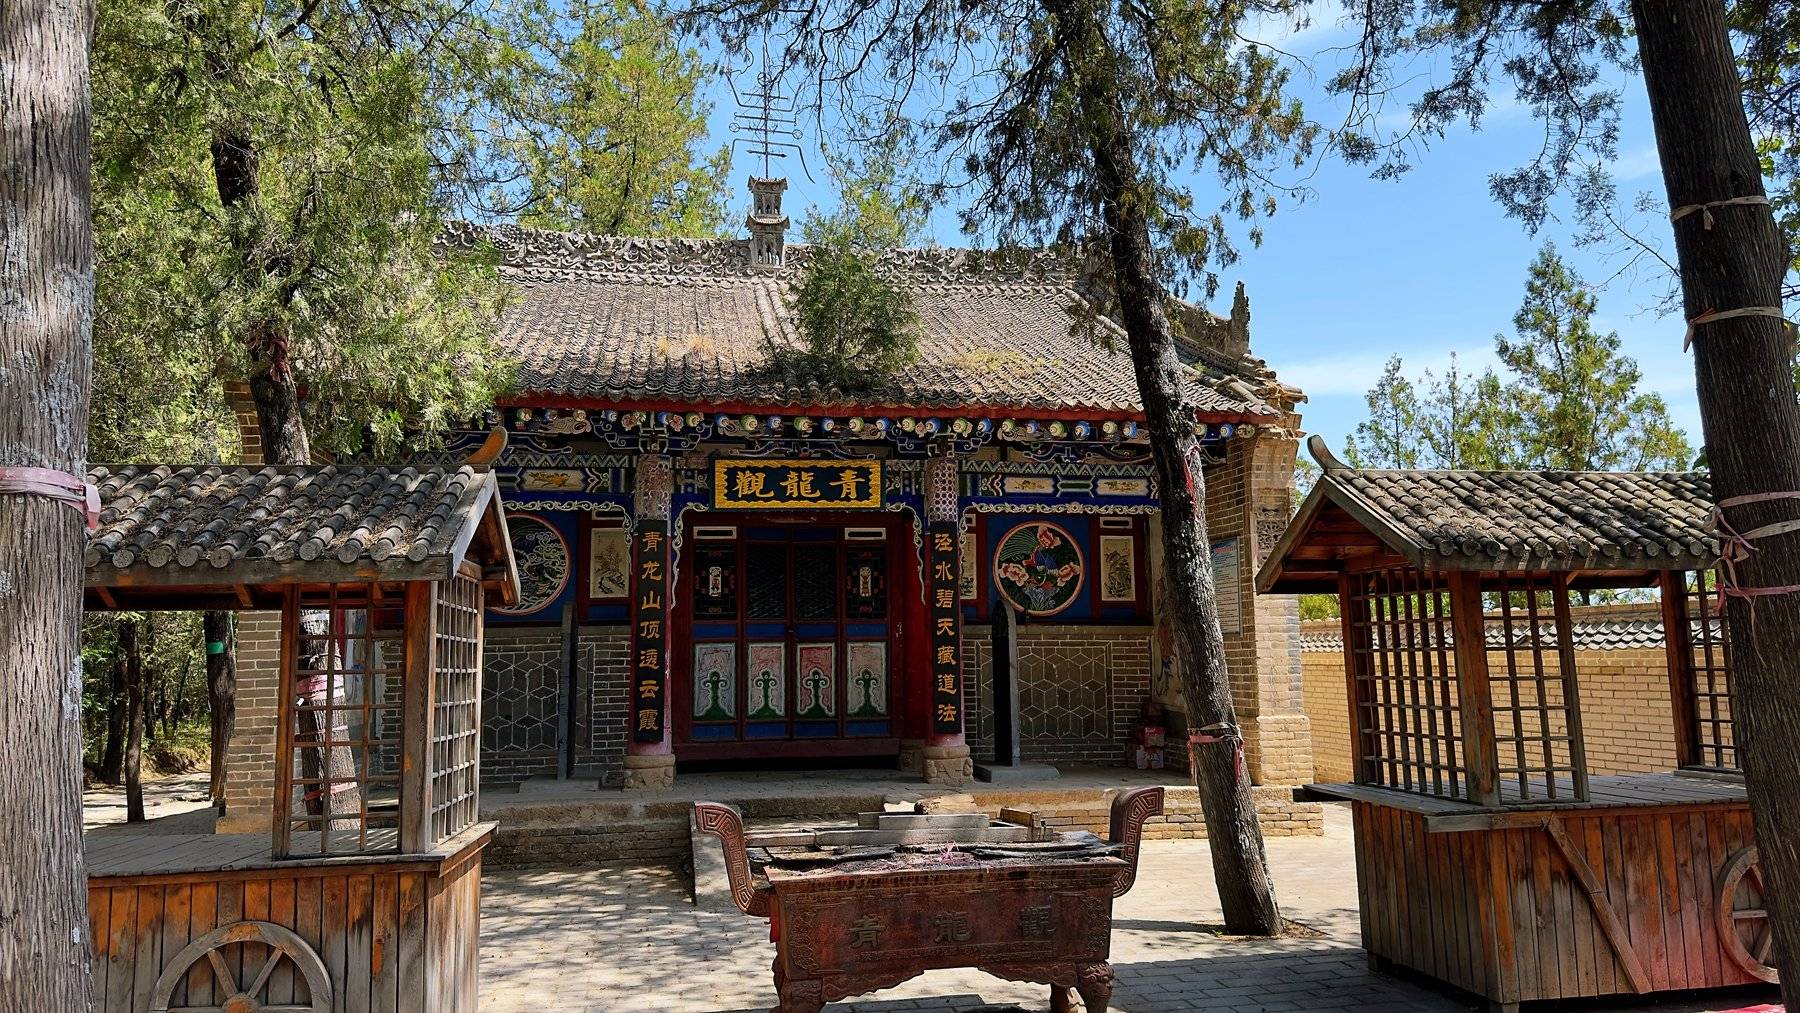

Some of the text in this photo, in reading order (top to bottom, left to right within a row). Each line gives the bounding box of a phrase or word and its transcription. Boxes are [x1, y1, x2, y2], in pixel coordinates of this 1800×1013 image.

[732, 469, 866, 499] 青龍觀
[850, 906, 1057, 948] 青龍觀
